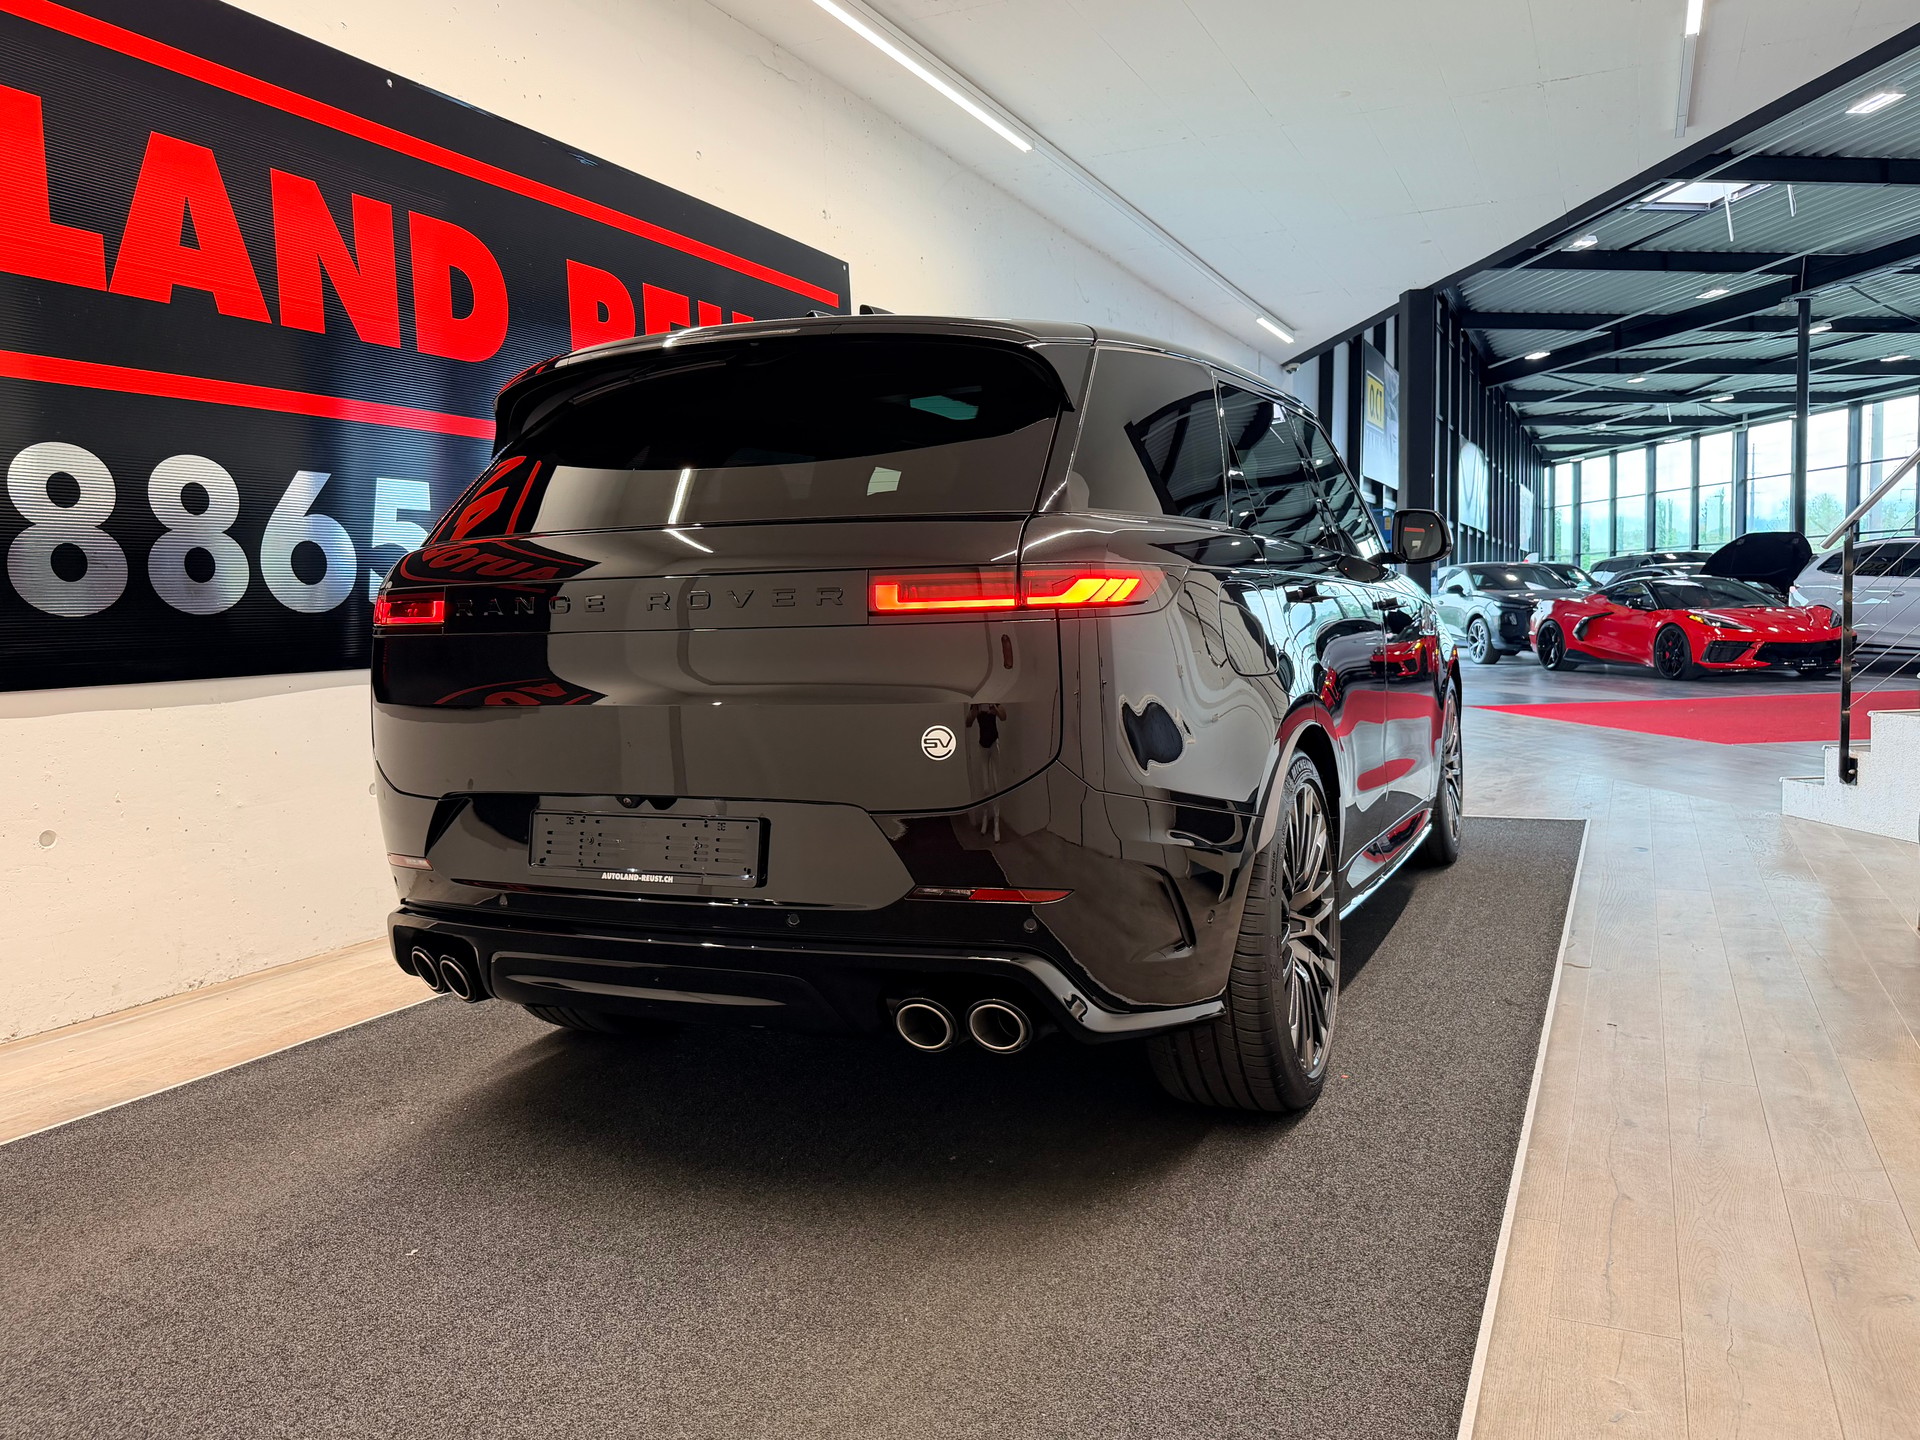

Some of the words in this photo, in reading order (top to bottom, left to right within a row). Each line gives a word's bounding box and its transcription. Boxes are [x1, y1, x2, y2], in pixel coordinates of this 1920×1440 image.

[7, 441, 431, 618] 8865
[456, 594, 606, 617] RANGE
[647, 587, 844, 612] ROVER
[601, 872, 674, 884] AUTOLAND-REUST.CH
